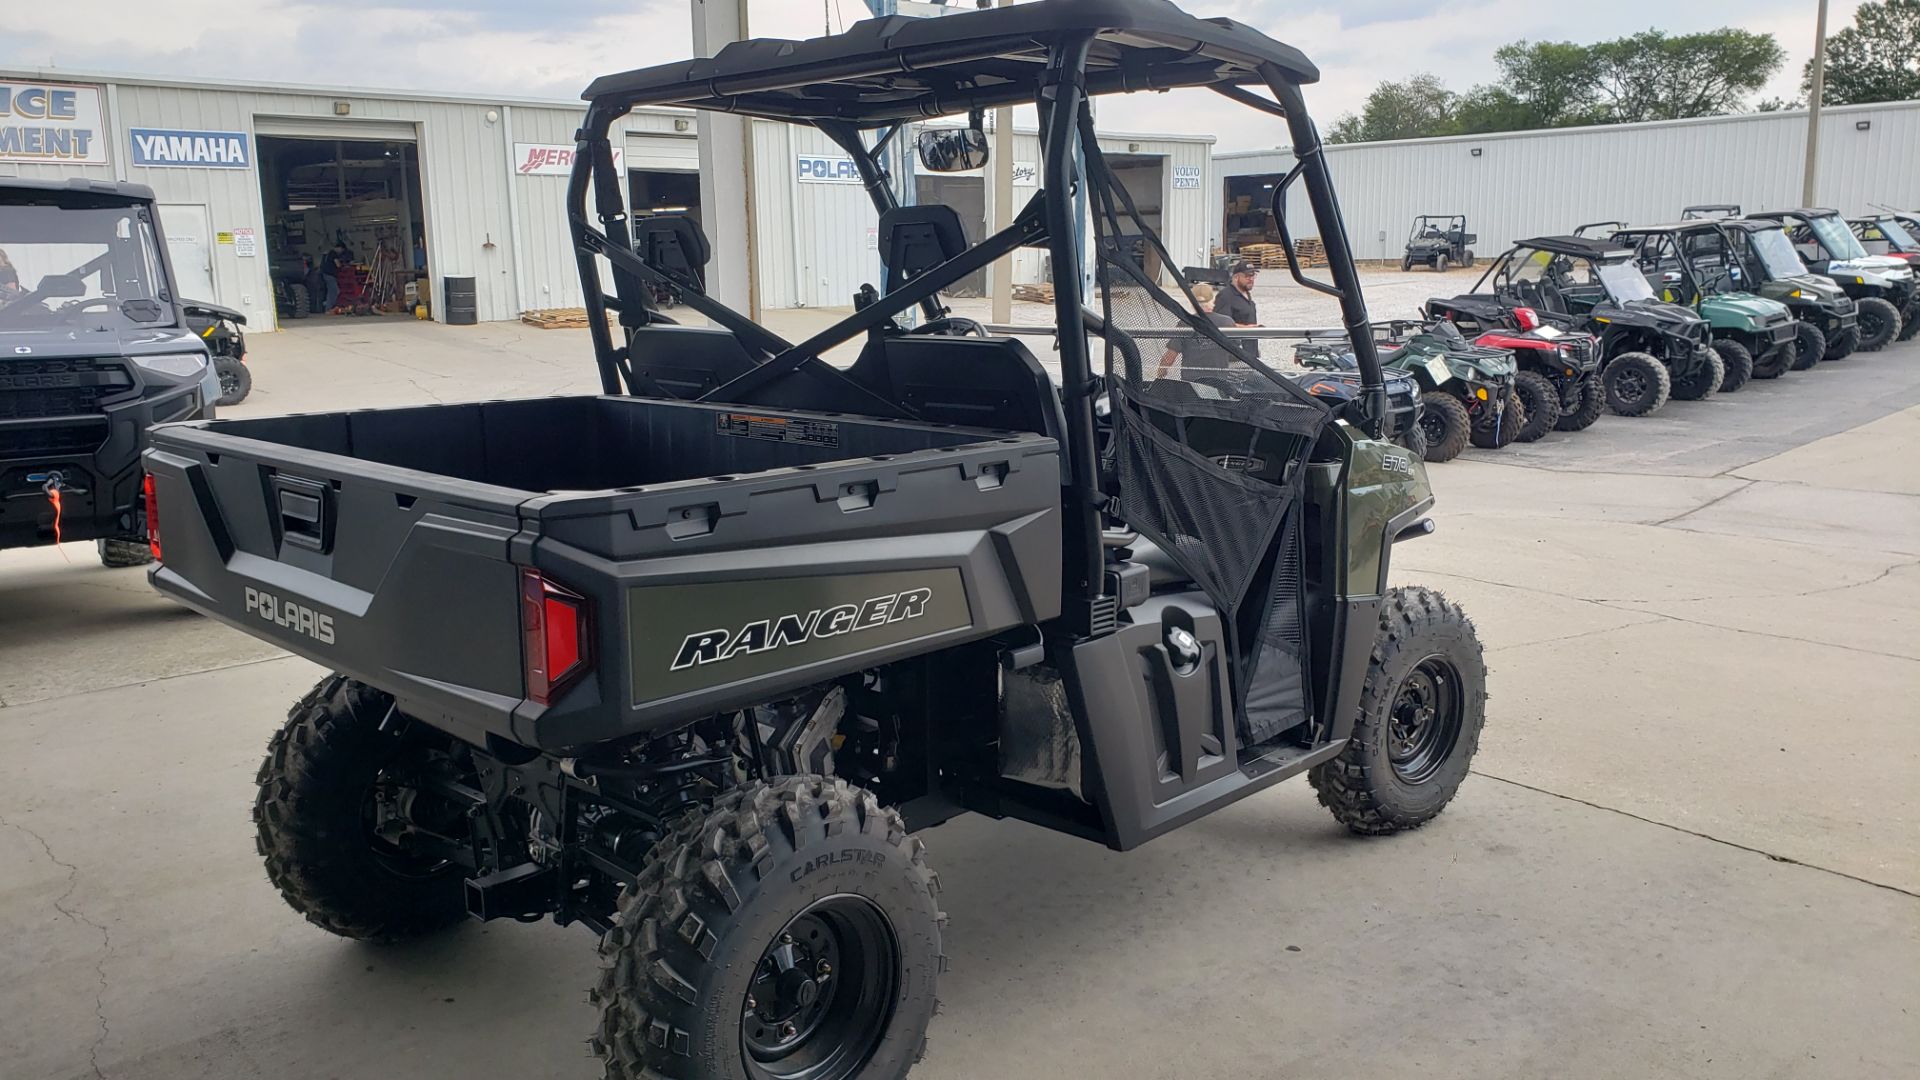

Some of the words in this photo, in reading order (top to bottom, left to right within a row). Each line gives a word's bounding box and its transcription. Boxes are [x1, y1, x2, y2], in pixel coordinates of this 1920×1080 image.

[135, 135, 244, 163] YAMAHA
[1175, 167, 1200, 176] VOLVO
[1175, 178, 1200, 187] PENTA
[1383, 454, 1407, 473] 570
[245, 586, 335, 645] POLARIS
[669, 587, 931, 671] RANGER
[790, 848, 886, 883] CARLSTAR
